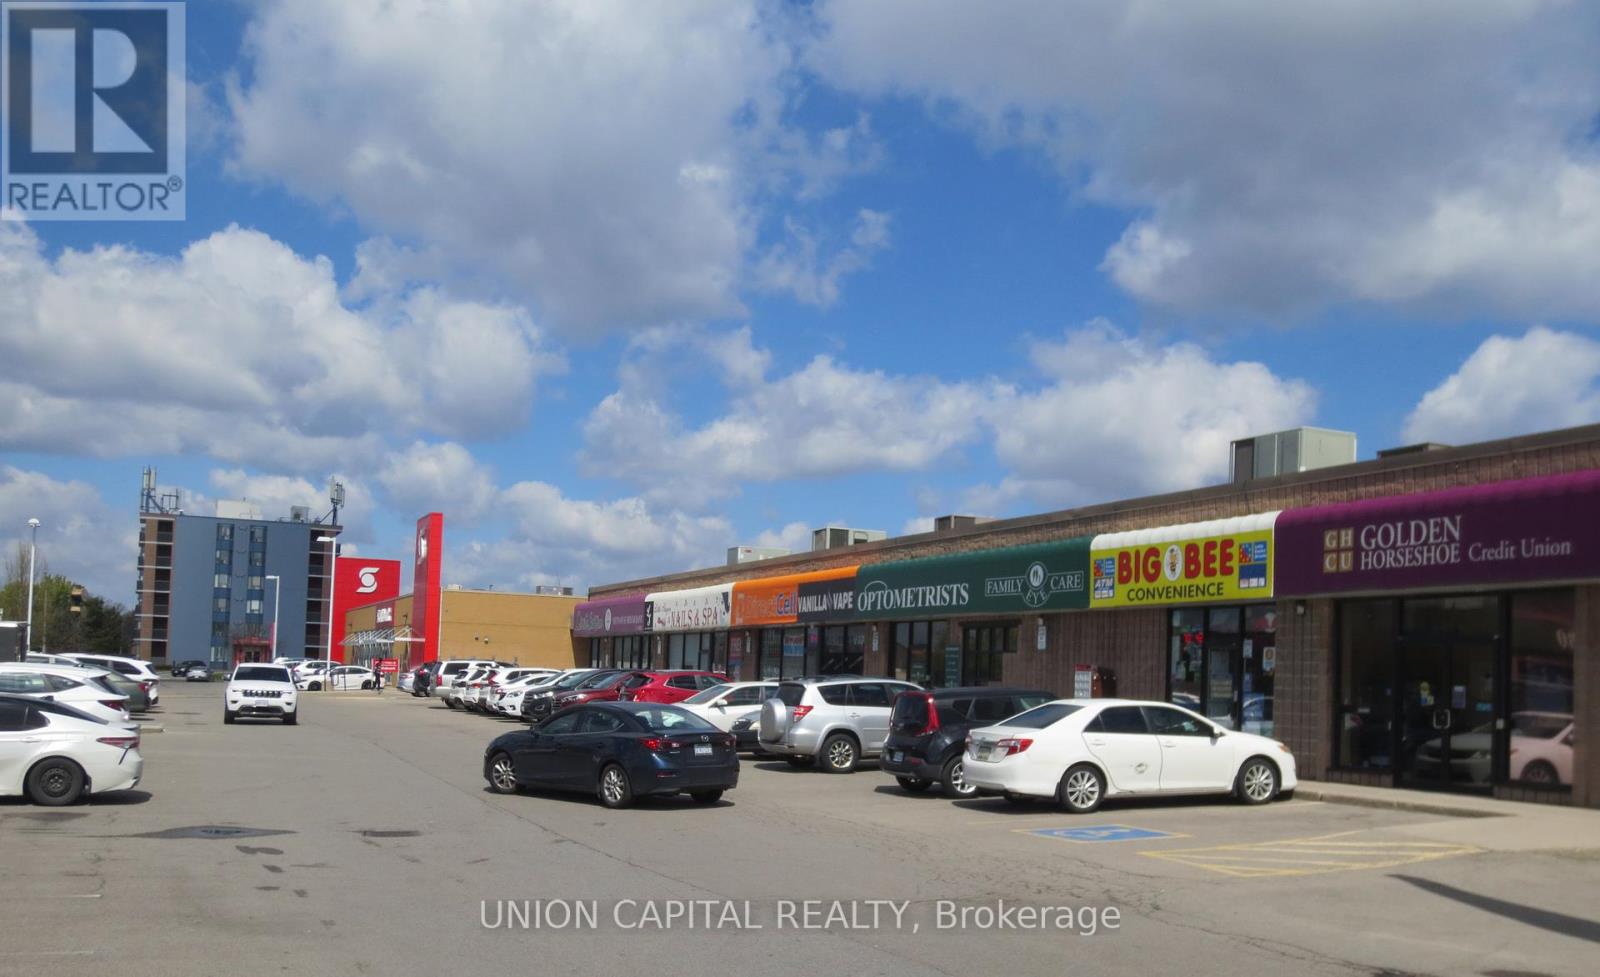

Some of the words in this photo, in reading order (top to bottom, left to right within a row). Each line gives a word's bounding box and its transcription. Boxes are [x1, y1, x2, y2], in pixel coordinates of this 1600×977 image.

[1360, 515, 1462, 550] GOLDEN
[1117, 547, 1161, 585] BIG
[1184, 539, 1235, 579] BEE
[1360, 543, 1460, 570] HORSESHOE
[1468, 541, 1515, 562] Credit
[1520, 537, 1572, 558] Union
[986, 578, 1024, 594] FAMILY
[1050, 574, 1082, 590] CARE
[1094, 578, 1113, 588] ATM
[1127, 582, 1224, 601] CONVENIENCE
[798, 594, 827, 613] VANILLA
[833, 591, 854, 610] VAPE
[857, 583, 969, 612] OPTOMETRISTS
[1025, 589, 1048, 605] EYE
[671, 608, 693, 627] NAILS
[702, 606, 718, 626] SPA
